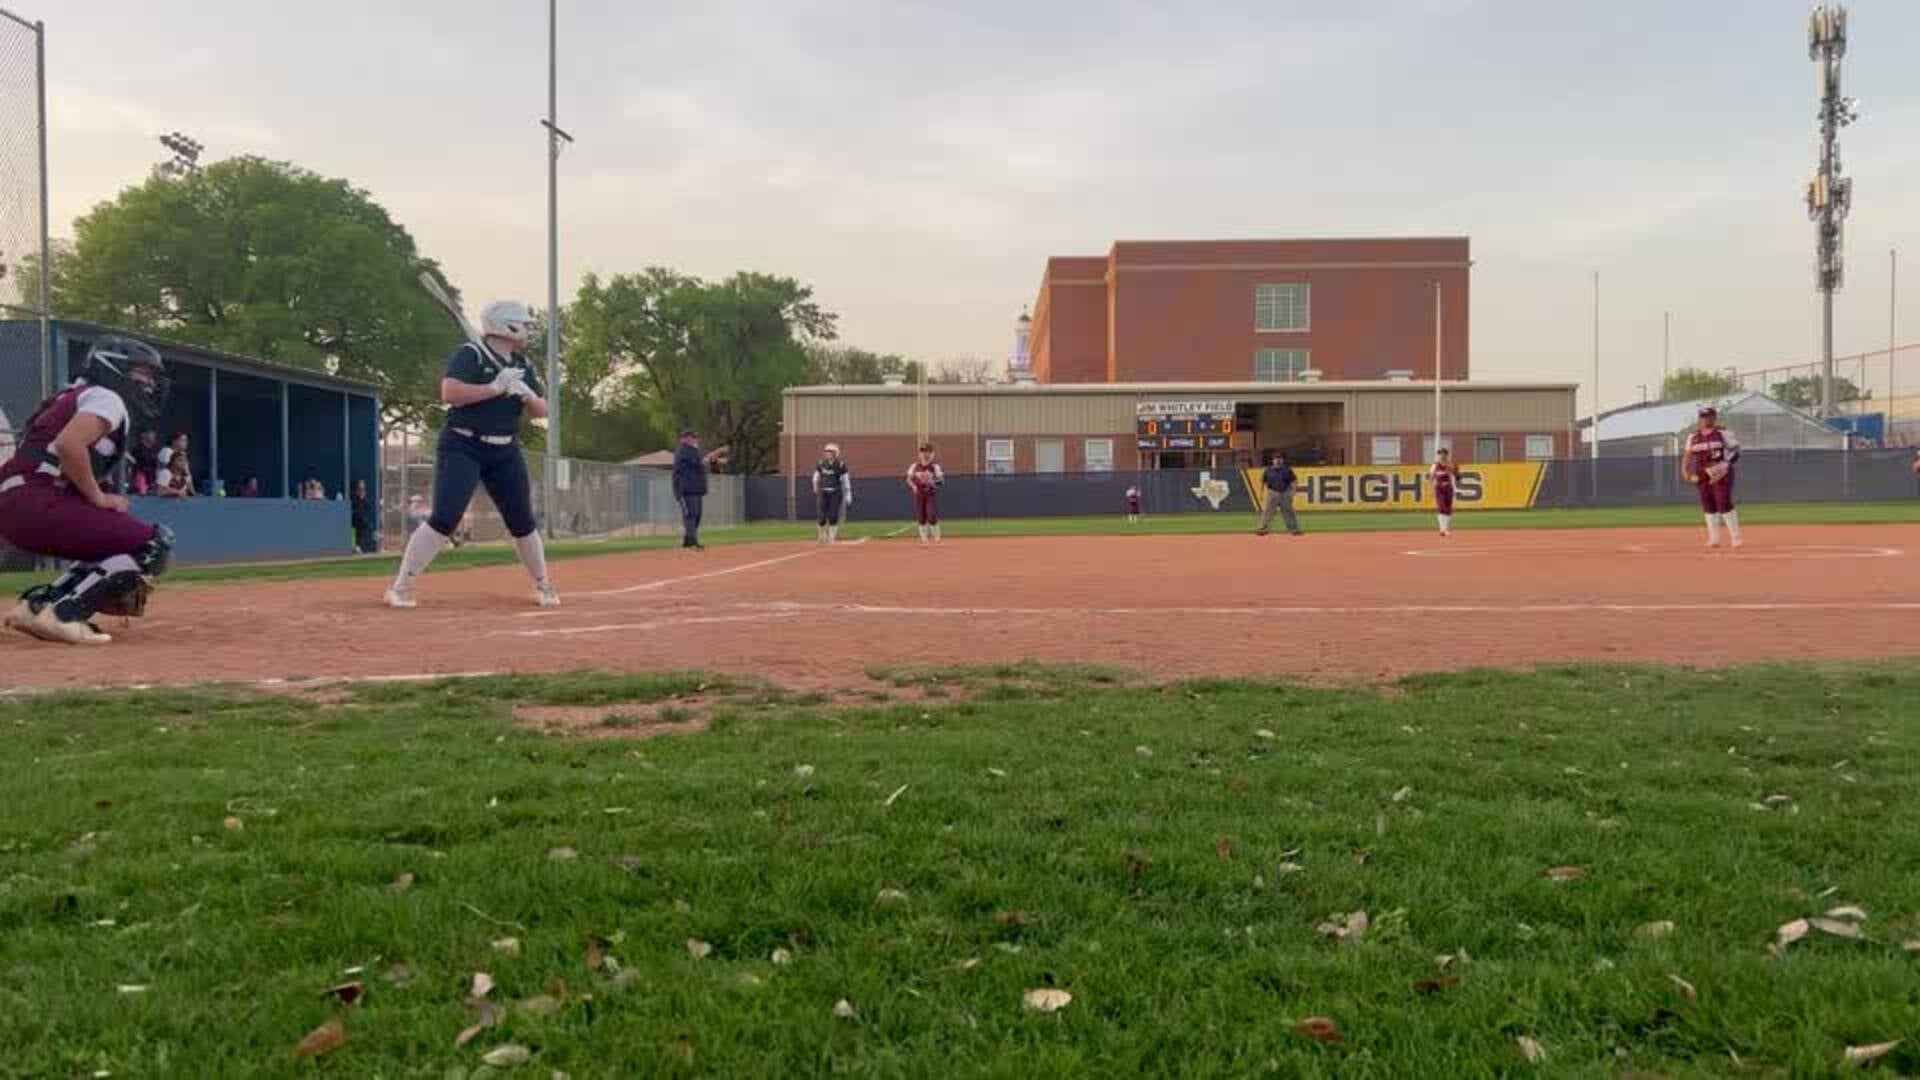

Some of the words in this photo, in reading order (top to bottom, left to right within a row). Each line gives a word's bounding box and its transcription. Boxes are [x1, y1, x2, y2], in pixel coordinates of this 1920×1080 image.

[1159, 403, 1202, 412] WHITLEY
[1205, 402, 1233, 411] FIELD
[1294, 471, 1483, 504] HEIGHS
